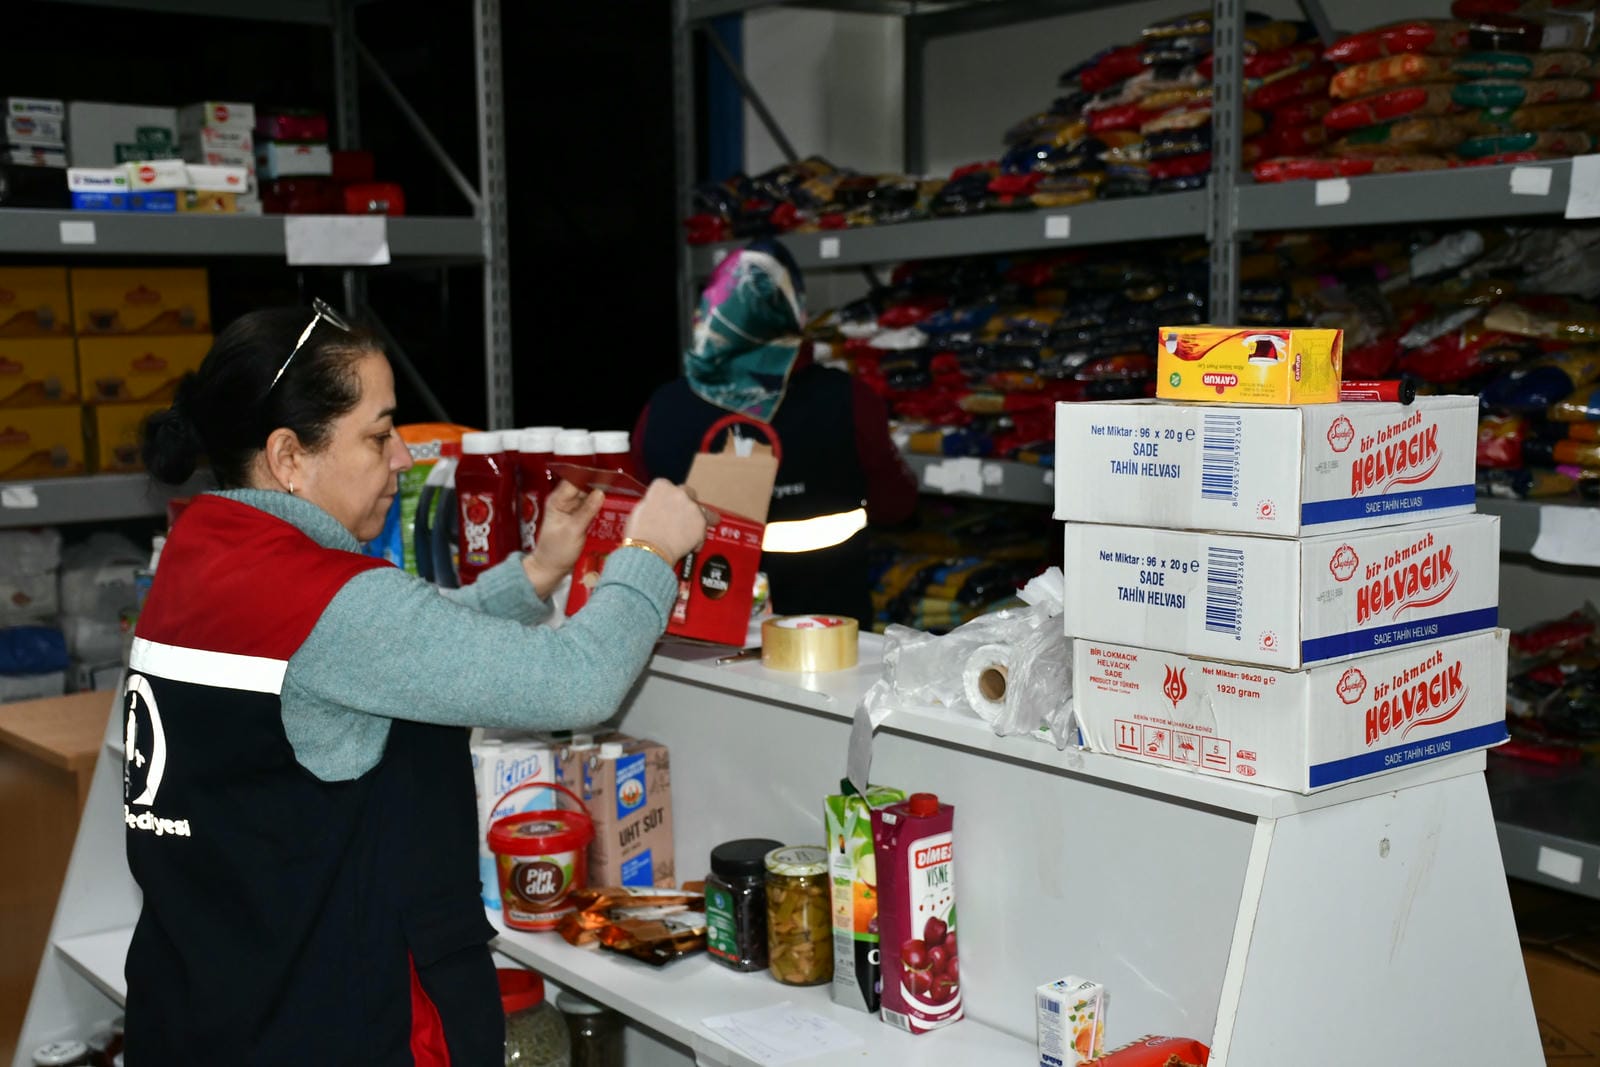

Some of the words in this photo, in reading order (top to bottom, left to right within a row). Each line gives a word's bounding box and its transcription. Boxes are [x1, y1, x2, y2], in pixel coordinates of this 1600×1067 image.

[1203, 374, 1237, 386] ÇAYKUR
[1091, 425, 1105, 436] Net
[1107, 426, 1133, 438] Miktar
[1140, 428, 1151, 438] 96
[1154, 430, 1161, 439] x
[1164, 429, 1175, 440] 20
[1177, 431, 1183, 442] g
[1133, 442, 1159, 457] SADE
[1361, 435, 1375, 453] bir
[1110, 459, 1139, 475] TAHİN
[1141, 463, 1181, 479] HELVASI
[1365, 501, 1382, 514] SADE
[1399, 496, 1423, 509] HELVASI
[1099, 550, 1114, 562] Net
[1114, 552, 1140, 565] Miktar
[1146, 556, 1157, 567] 96
[1160, 560, 1166, 569] x
[1170, 559, 1181, 570] 20
[1182, 562, 1188, 573] g
[1140, 570, 1165, 586] SADE
[1366, 563, 1381, 581] bir
[1118, 587, 1145, 604] TAHİN
[1147, 590, 1186, 609] HELVASI
[1374, 632, 1392, 645] SADE
[1412, 624, 1439, 639] HELVASI
[1090, 647, 1102, 656] BİR
[1103, 650, 1138, 662] LOKMACIK
[1097, 659, 1131, 670] HELVACIK
[1104, 669, 1123, 678] SADE
[1202, 667, 1215, 676] Net
[1216, 669, 1239, 679] Miktar:
[1240, 672, 1262, 683] 96x20
[1216, 684, 1237, 695] 1920
[1238, 688, 1260, 698] gram
[1374, 682, 1390, 702] bir
[1213, 745, 1219, 754] 5
[1384, 753, 1403, 766] SADE
[1404, 749, 1424, 761] TAHİN
[1424, 741, 1451, 756] HELVASI
[618, 820, 641, 847] UHT
[525, 879, 556, 895] duk
